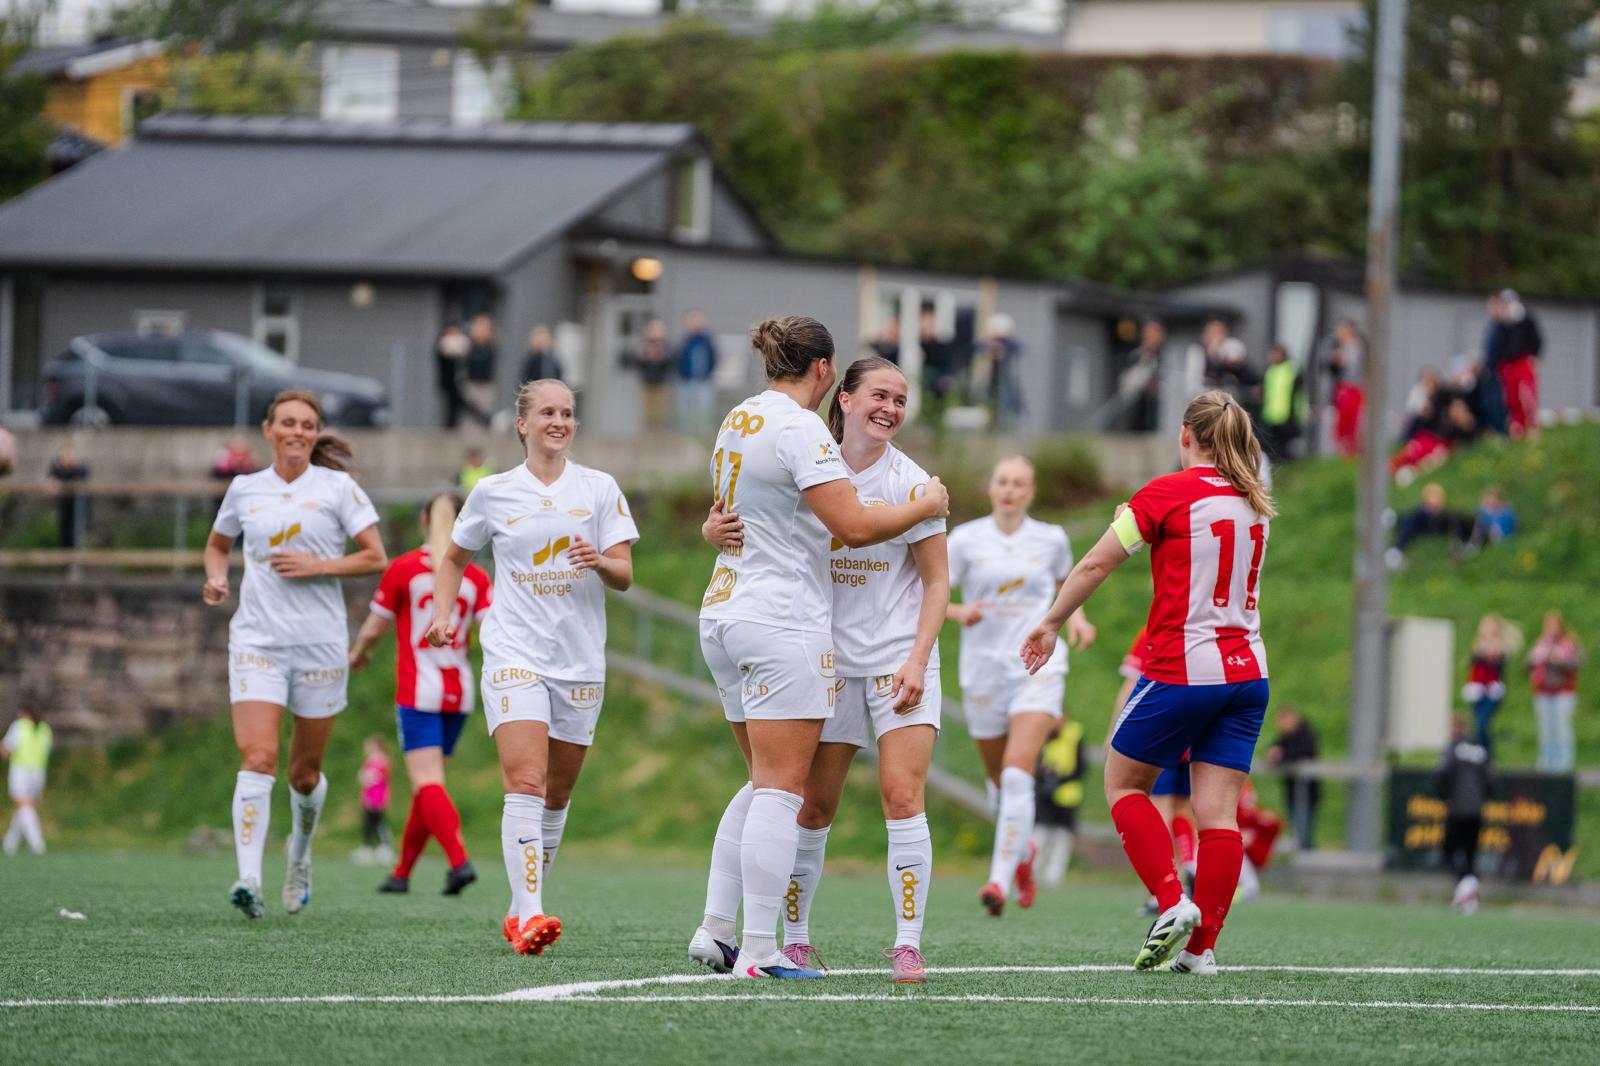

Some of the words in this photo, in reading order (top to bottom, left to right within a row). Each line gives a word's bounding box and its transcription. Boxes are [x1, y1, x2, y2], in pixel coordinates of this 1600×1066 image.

[714, 447, 743, 513] 17
[830, 557, 890, 572] rebanken
[1210, 519, 1264, 610] 11
[533, 582, 572, 597] Norge
[501, 696, 509, 713] 9
[524, 845, 540, 893] coop
[786, 880, 804, 923] coop
[901, 871, 919, 921] coop
